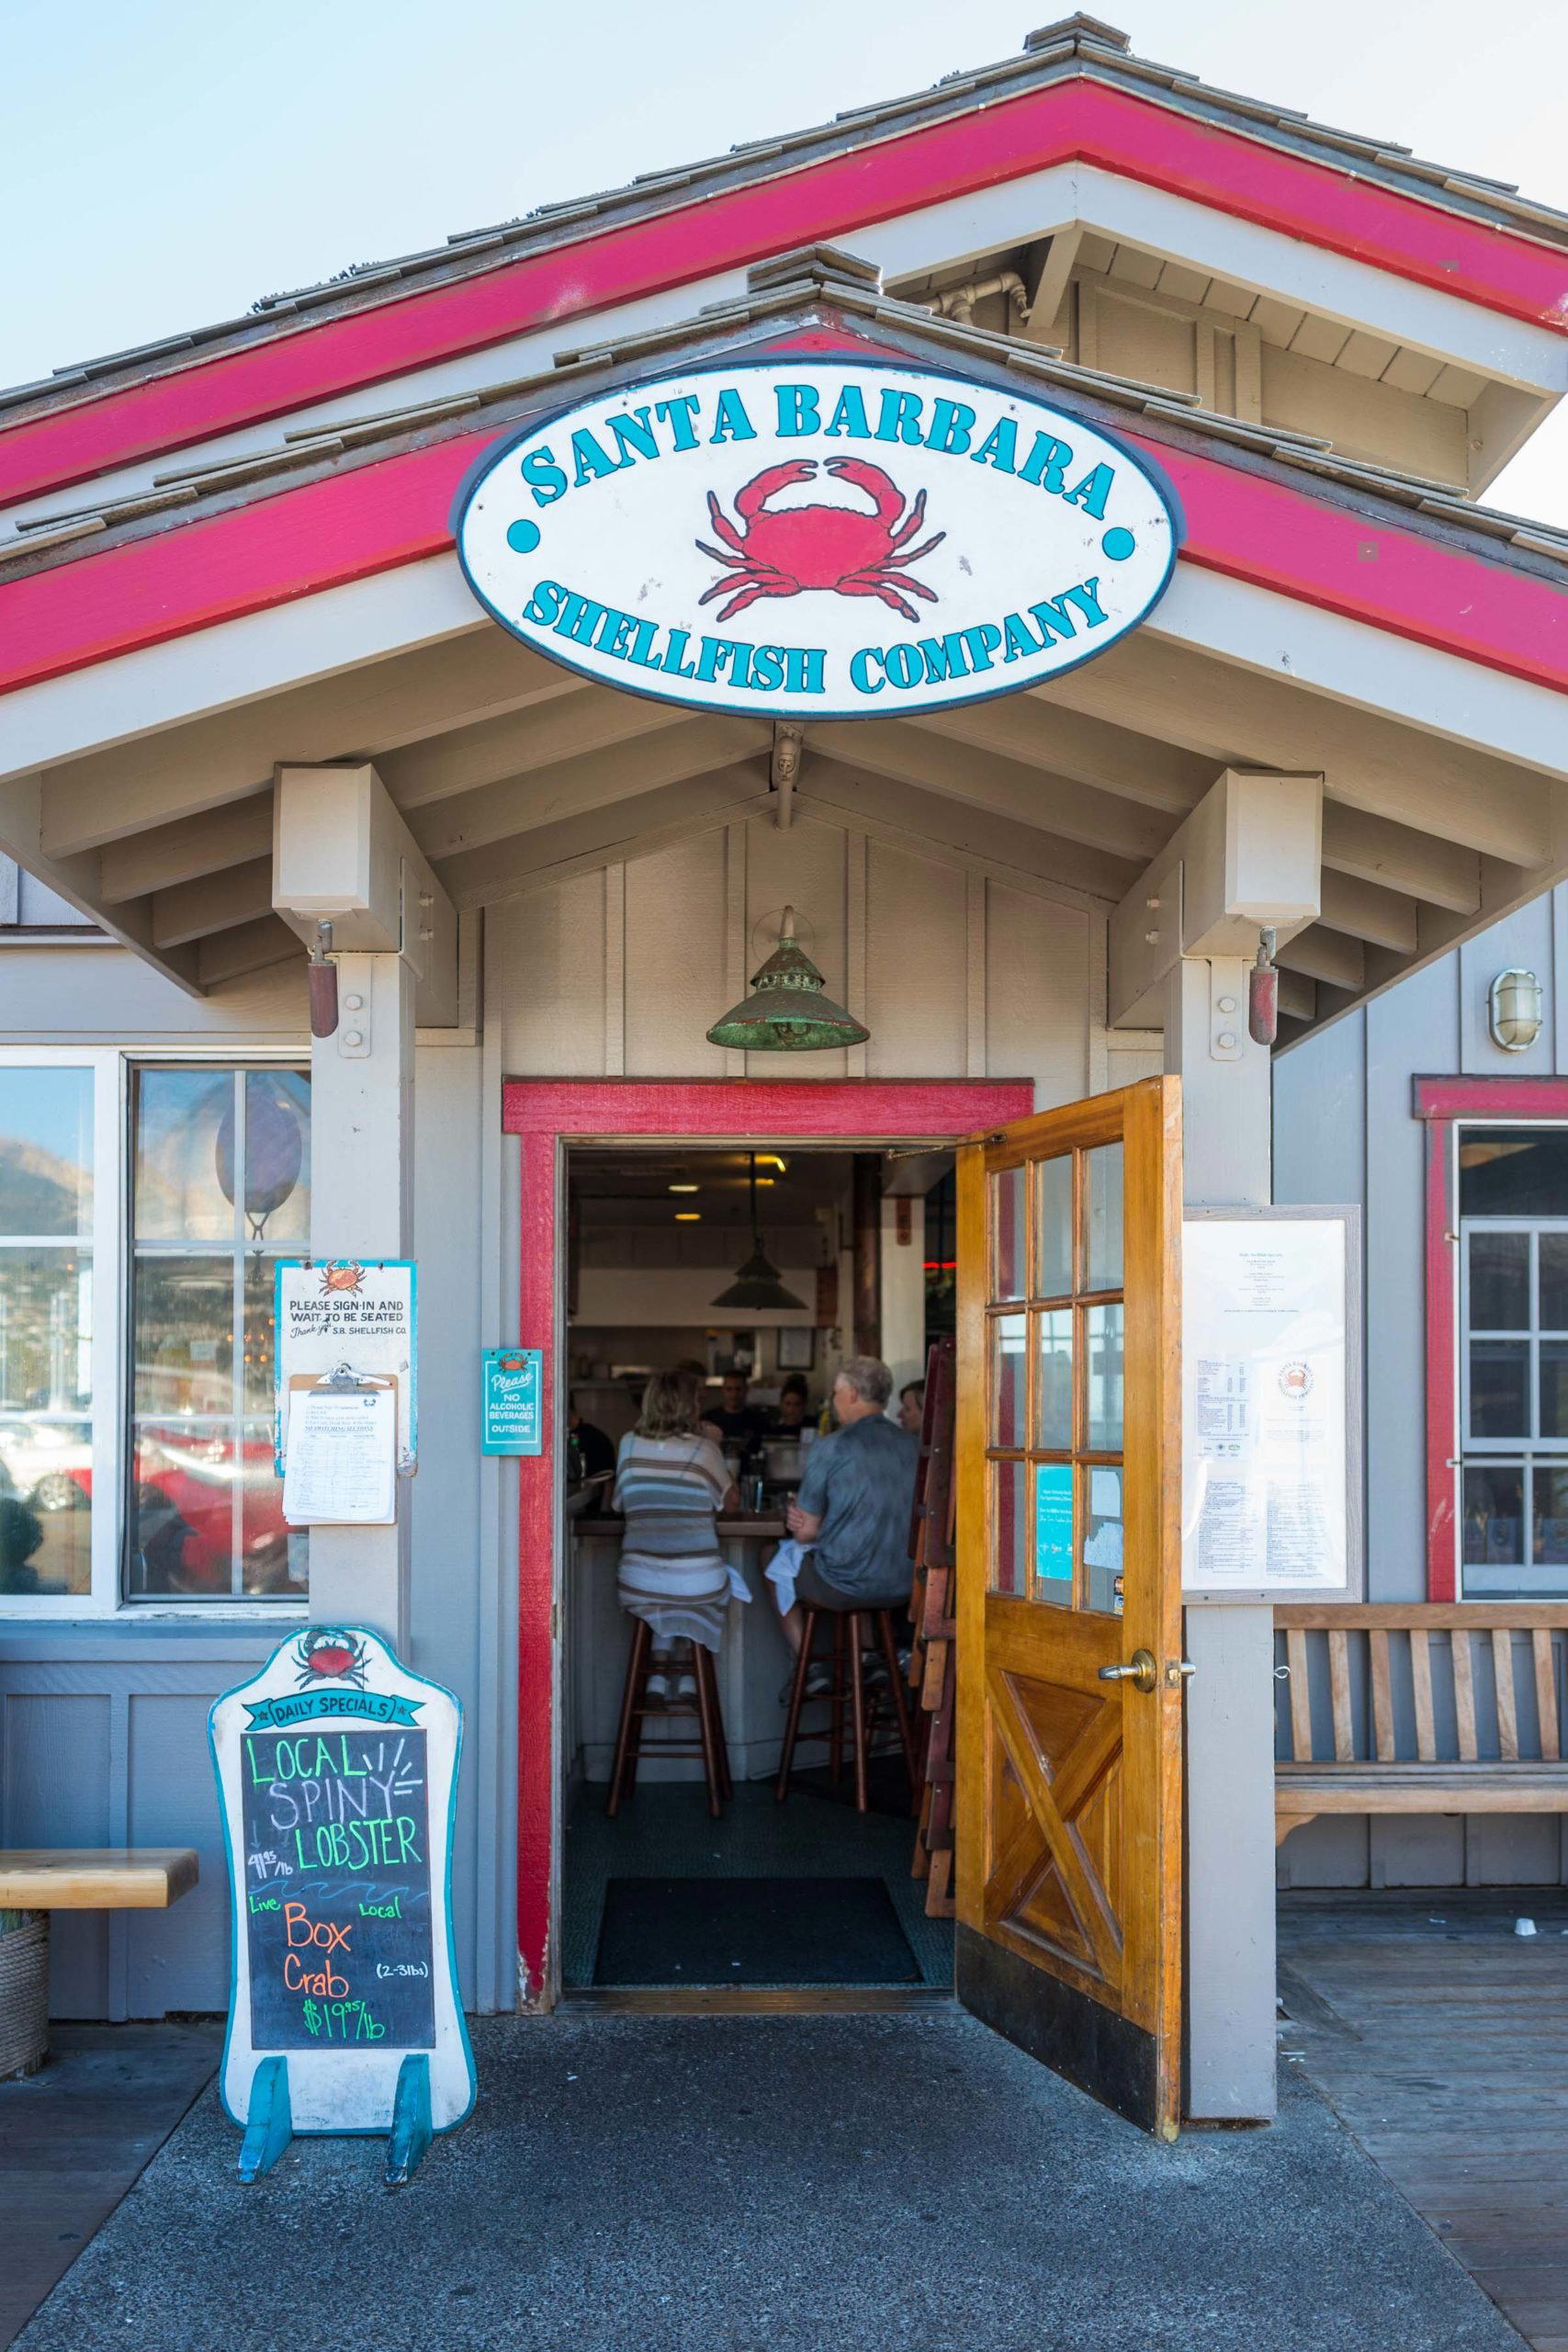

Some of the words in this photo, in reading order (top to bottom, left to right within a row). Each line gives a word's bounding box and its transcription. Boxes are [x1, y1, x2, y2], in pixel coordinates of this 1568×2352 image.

[520, 388, 758, 508] SANTA
[773, 384, 1117, 521] BARBARA
[522, 580, 828, 695] SHELLFISH
[849, 576, 1111, 695] COMPANY
[289, 1300, 331, 1311] PLEASE
[378, 1301, 403, 1311] AND
[290, 1313, 321, 1322] WAIT
[324, 1313, 341, 1322] TO
[344, 1313, 357, 1322] BE
[360, 1313, 403, 1322] SEATED
[289, 1324, 316, 1339] Thank
[348, 1327, 394, 1335] SHELLFISH
[491, 1372, 534, 1392] Please
[490, 1402, 535, 1411] ALCOHOLIC
[503, 1393, 521, 1402] NO
[489, 1411, 535, 1419] BEVERAGES
[491, 1424, 531, 1433] OUTSIDE
[276, 1699, 314, 1722] DAILY
[319, 1697, 389, 1717] SPECIALS
[246, 1735, 367, 1784] LOCAL
[269, 1770, 396, 1830] SPINY
[295, 1815, 423, 1871] LOBSTER
[249, 1895, 281, 1915] Live
[359, 1895, 402, 1919] Local
[284, 1902, 353, 1954] Box
[284, 1953, 350, 1998] Crab
